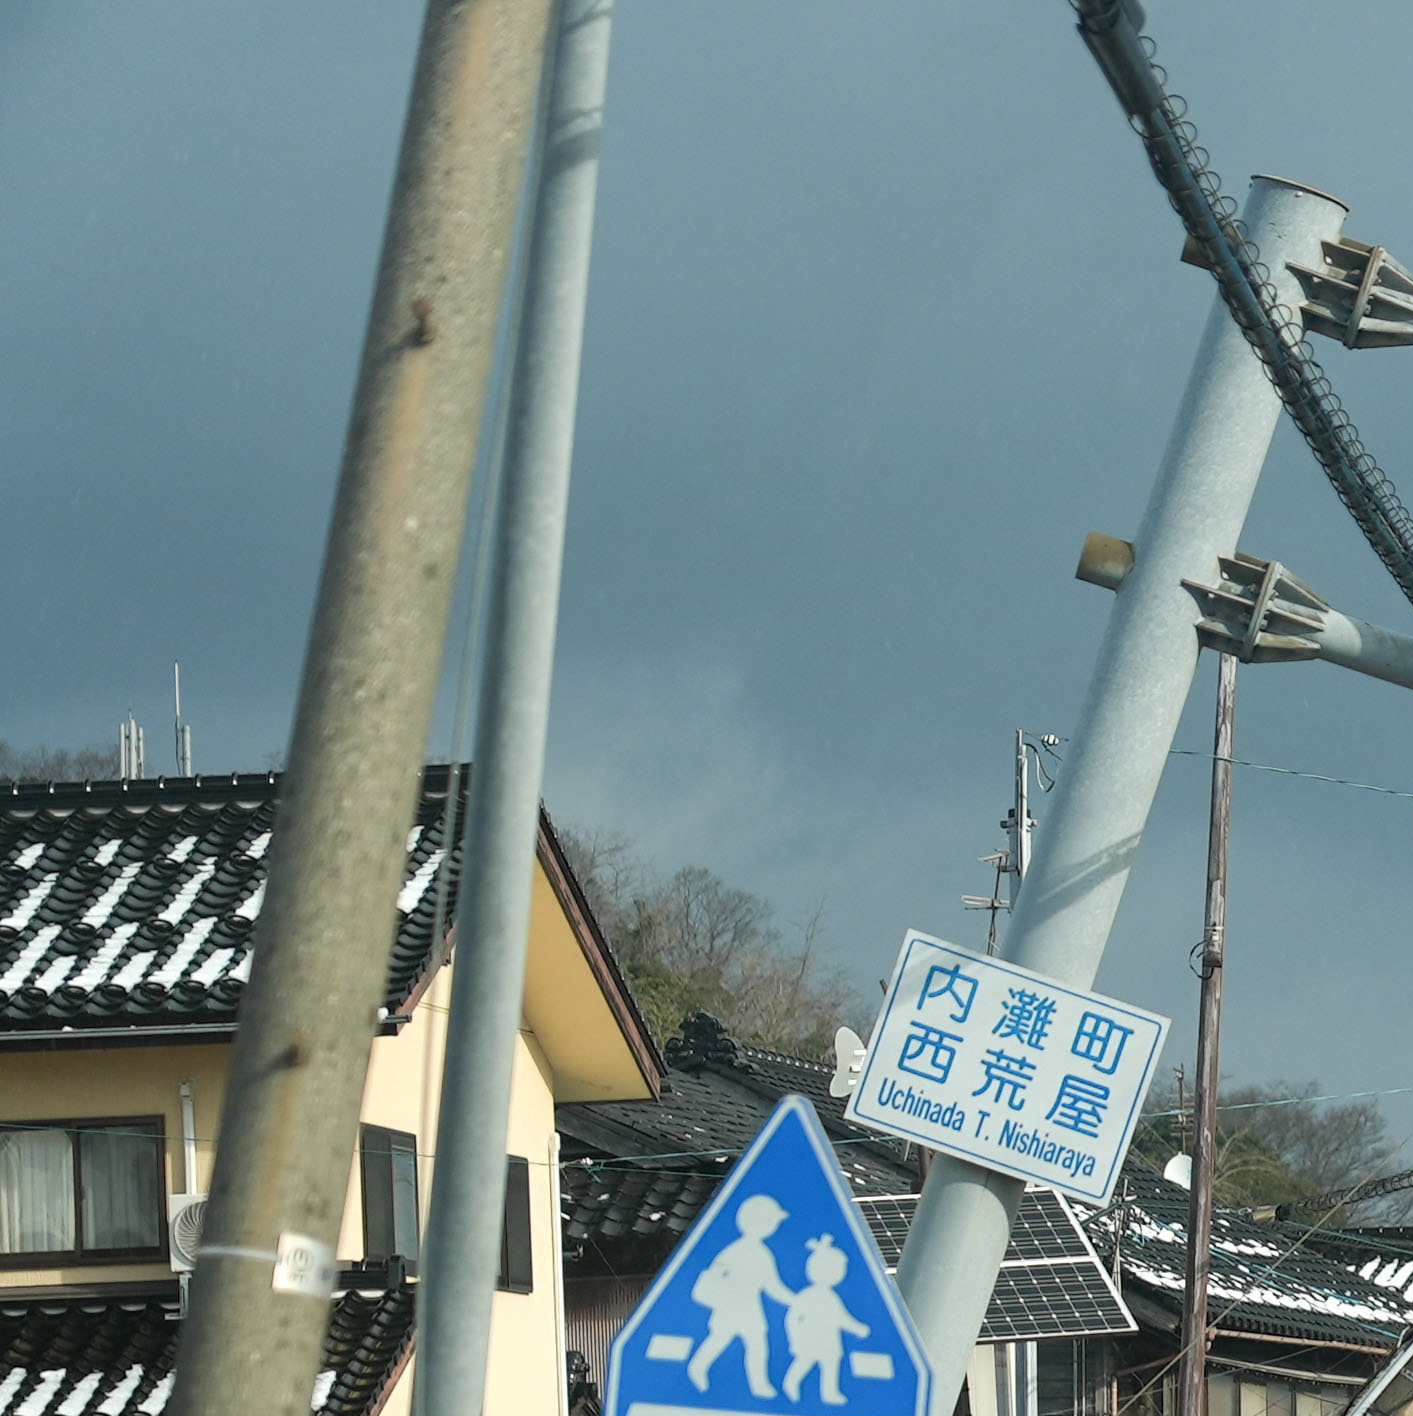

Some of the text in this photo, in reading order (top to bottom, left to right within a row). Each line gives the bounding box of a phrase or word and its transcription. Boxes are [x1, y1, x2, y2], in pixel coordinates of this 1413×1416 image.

[919, 962, 1134, 1076] 内灘町
[877, 1077, 1097, 1180] Uchinada T. Nishiaraya
[899, 1022, 1112, 1141] 西荒屋
